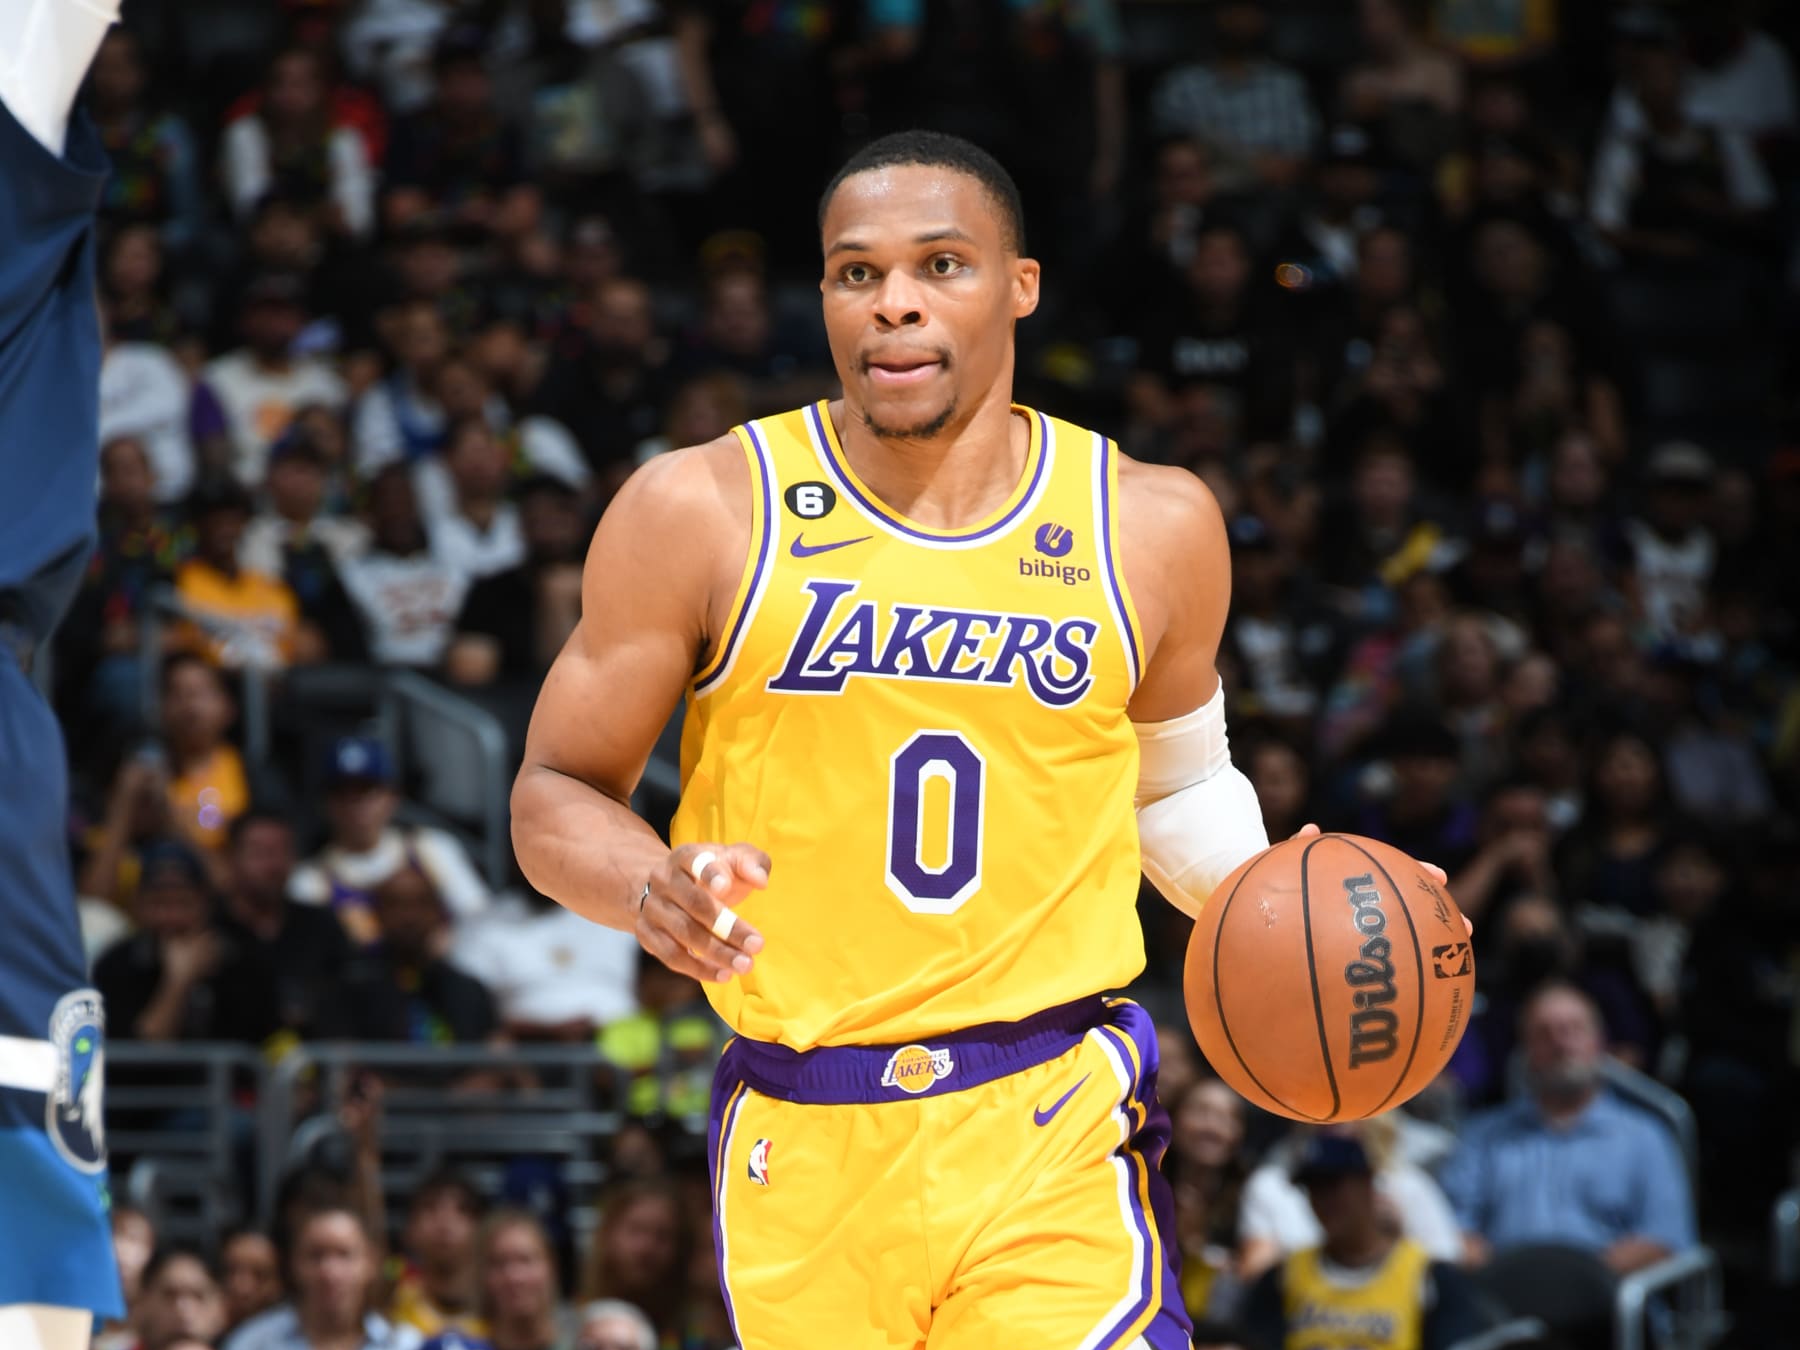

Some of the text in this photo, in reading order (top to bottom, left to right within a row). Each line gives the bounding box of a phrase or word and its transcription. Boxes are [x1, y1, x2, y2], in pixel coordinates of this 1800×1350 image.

[796, 486, 824, 515] 6
[1019, 558, 1090, 585] bibigo
[766, 578, 1101, 708] LAKERS
[886, 729, 985, 914] 0
[1343, 873, 1398, 1070] Wilson
